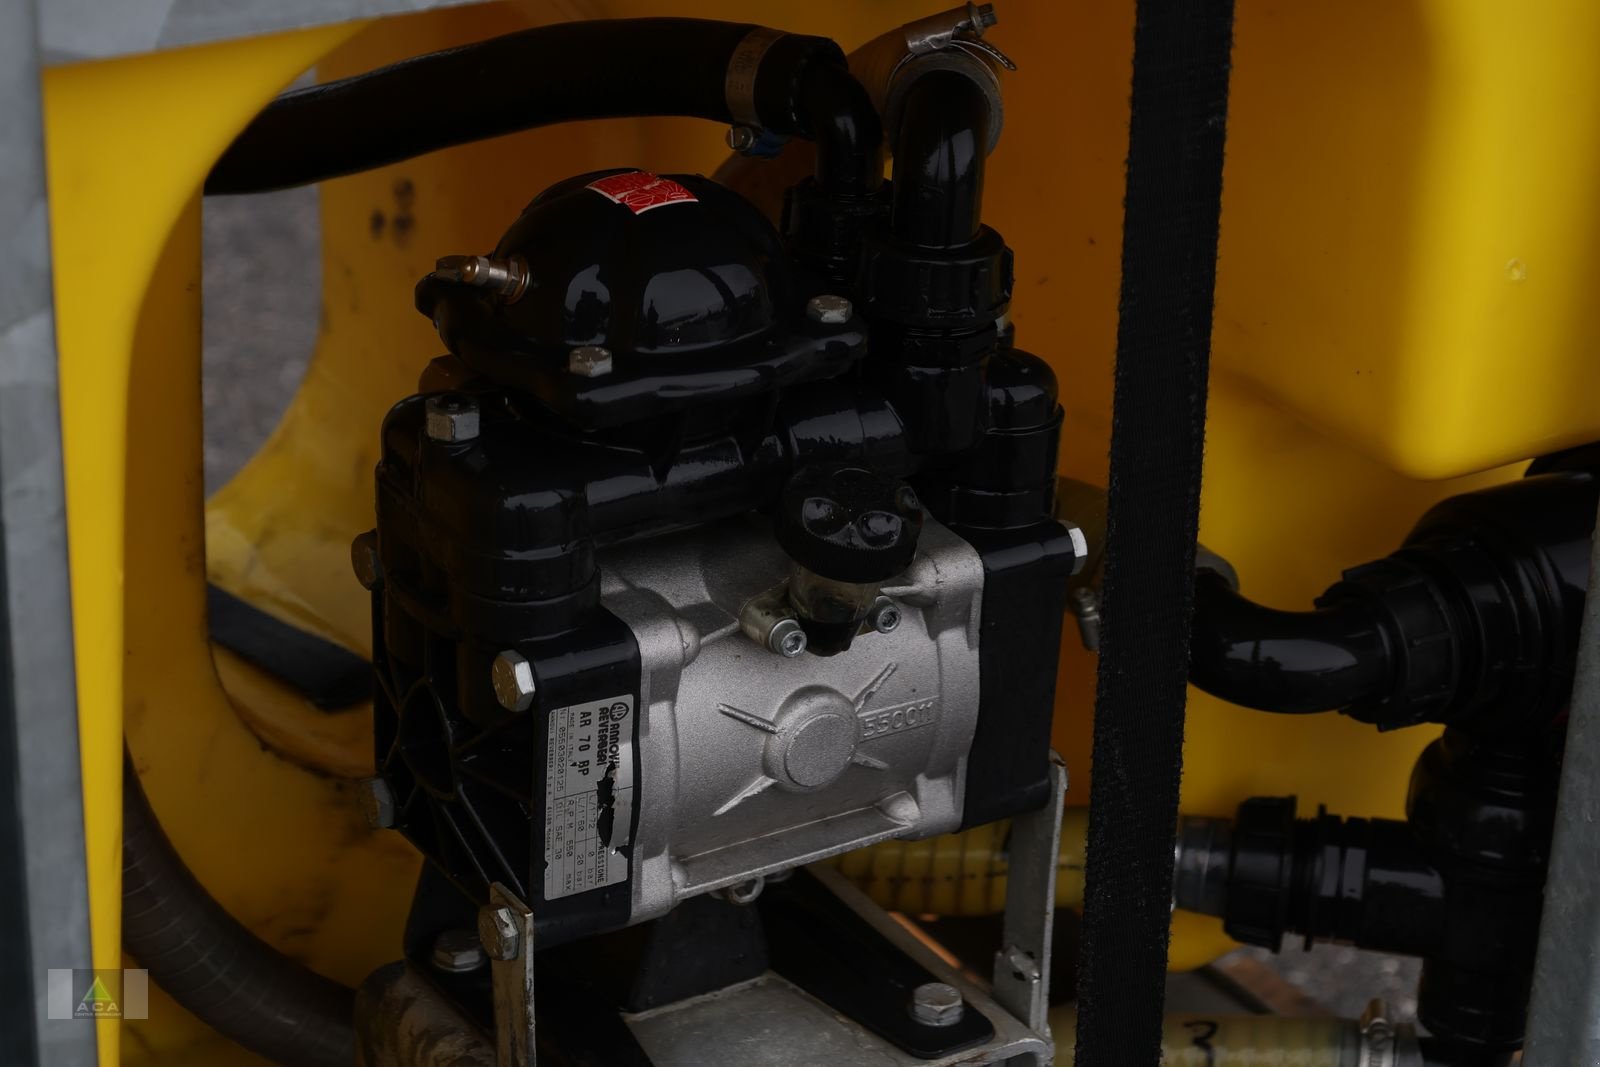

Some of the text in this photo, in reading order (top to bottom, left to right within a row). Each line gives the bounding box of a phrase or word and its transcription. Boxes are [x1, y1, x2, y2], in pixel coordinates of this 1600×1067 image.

[578, 711, 591, 776] AR 70 BP
[597, 707, 609, 766] REVERBERI
[556, 801, 564, 820] OIL
[555, 848, 562, 860] 30
[566, 840, 574, 857] 550
[577, 854, 584, 865] 20
[597, 841, 605, 883] PRESSIONE
[576, 870, 584, 887] bar
[587, 868, 595, 884] bar
